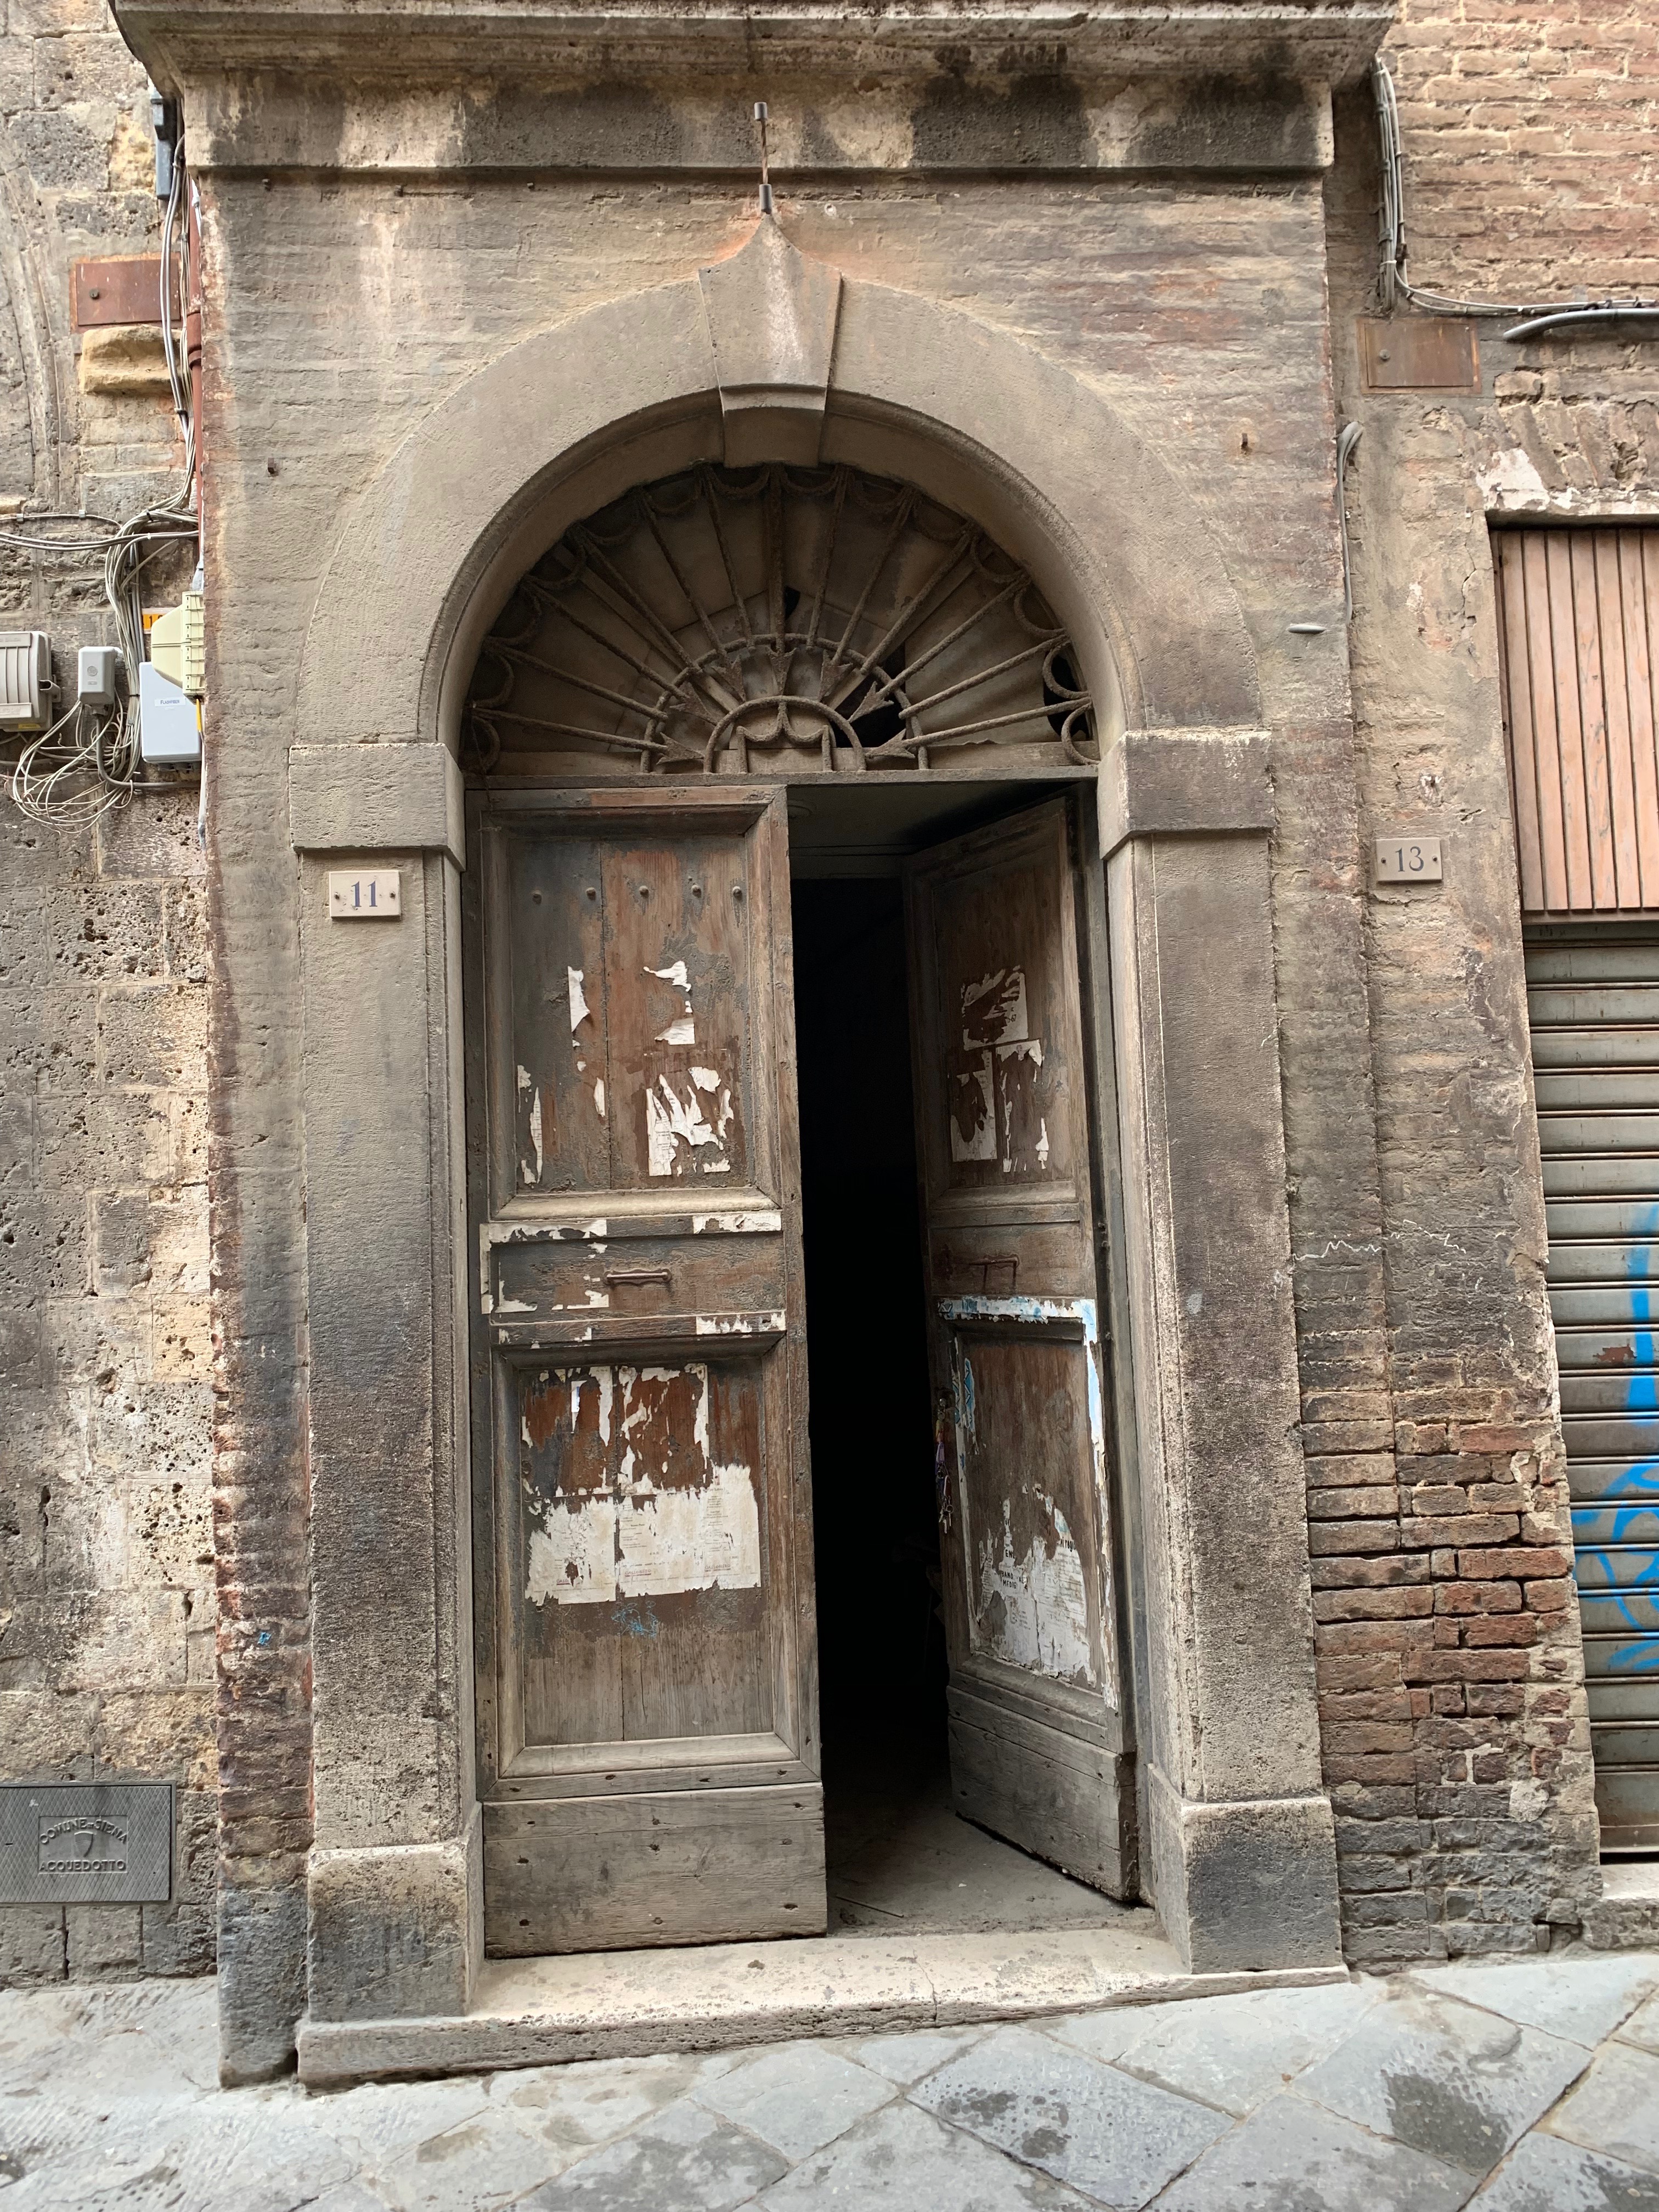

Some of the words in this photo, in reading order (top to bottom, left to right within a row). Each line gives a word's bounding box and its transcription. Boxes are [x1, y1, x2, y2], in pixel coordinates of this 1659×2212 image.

[1395, 846, 1424, 872] 13
[351, 880, 377, 907] 11
[40, 1817, 88, 1844] COMUNE
[94, 1819, 128, 1844] SIENA
[39, 1859, 126, 1871] ACQUEDOTTO
